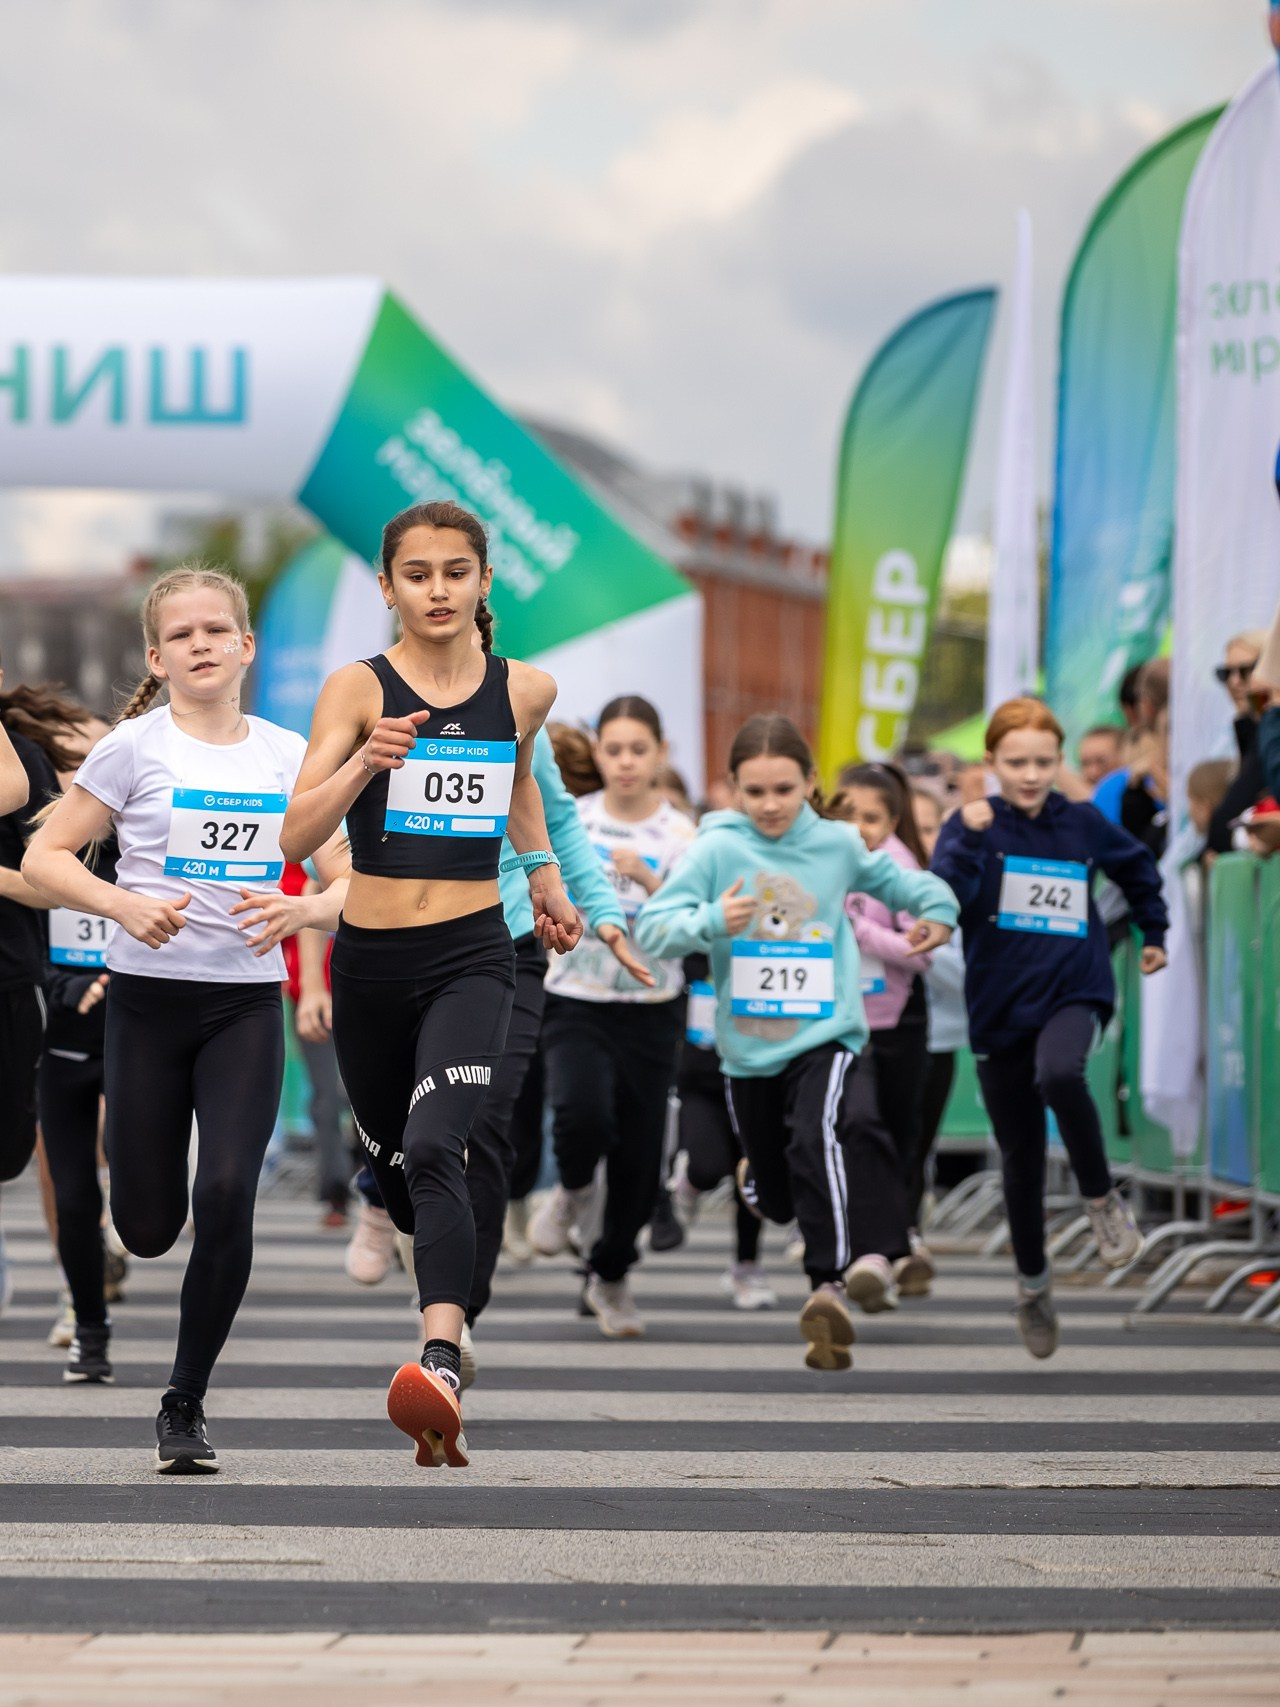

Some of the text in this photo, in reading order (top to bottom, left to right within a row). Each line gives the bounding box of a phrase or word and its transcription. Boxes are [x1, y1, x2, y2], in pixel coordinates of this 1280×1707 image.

[439, 745, 489, 756] СБЕР KIDS
[424, 772, 485, 804] 035
[217, 797, 263, 807] СБЕР KIDS
[404, 815, 430, 830] 420
[201, 821, 260, 851] 327
[182, 861, 207, 875] 420
[1028, 883, 1072, 910] 242
[77, 919, 107, 941] 31
[759, 967, 808, 991] 219
[408, 1065, 491, 1115] MA PUMA
